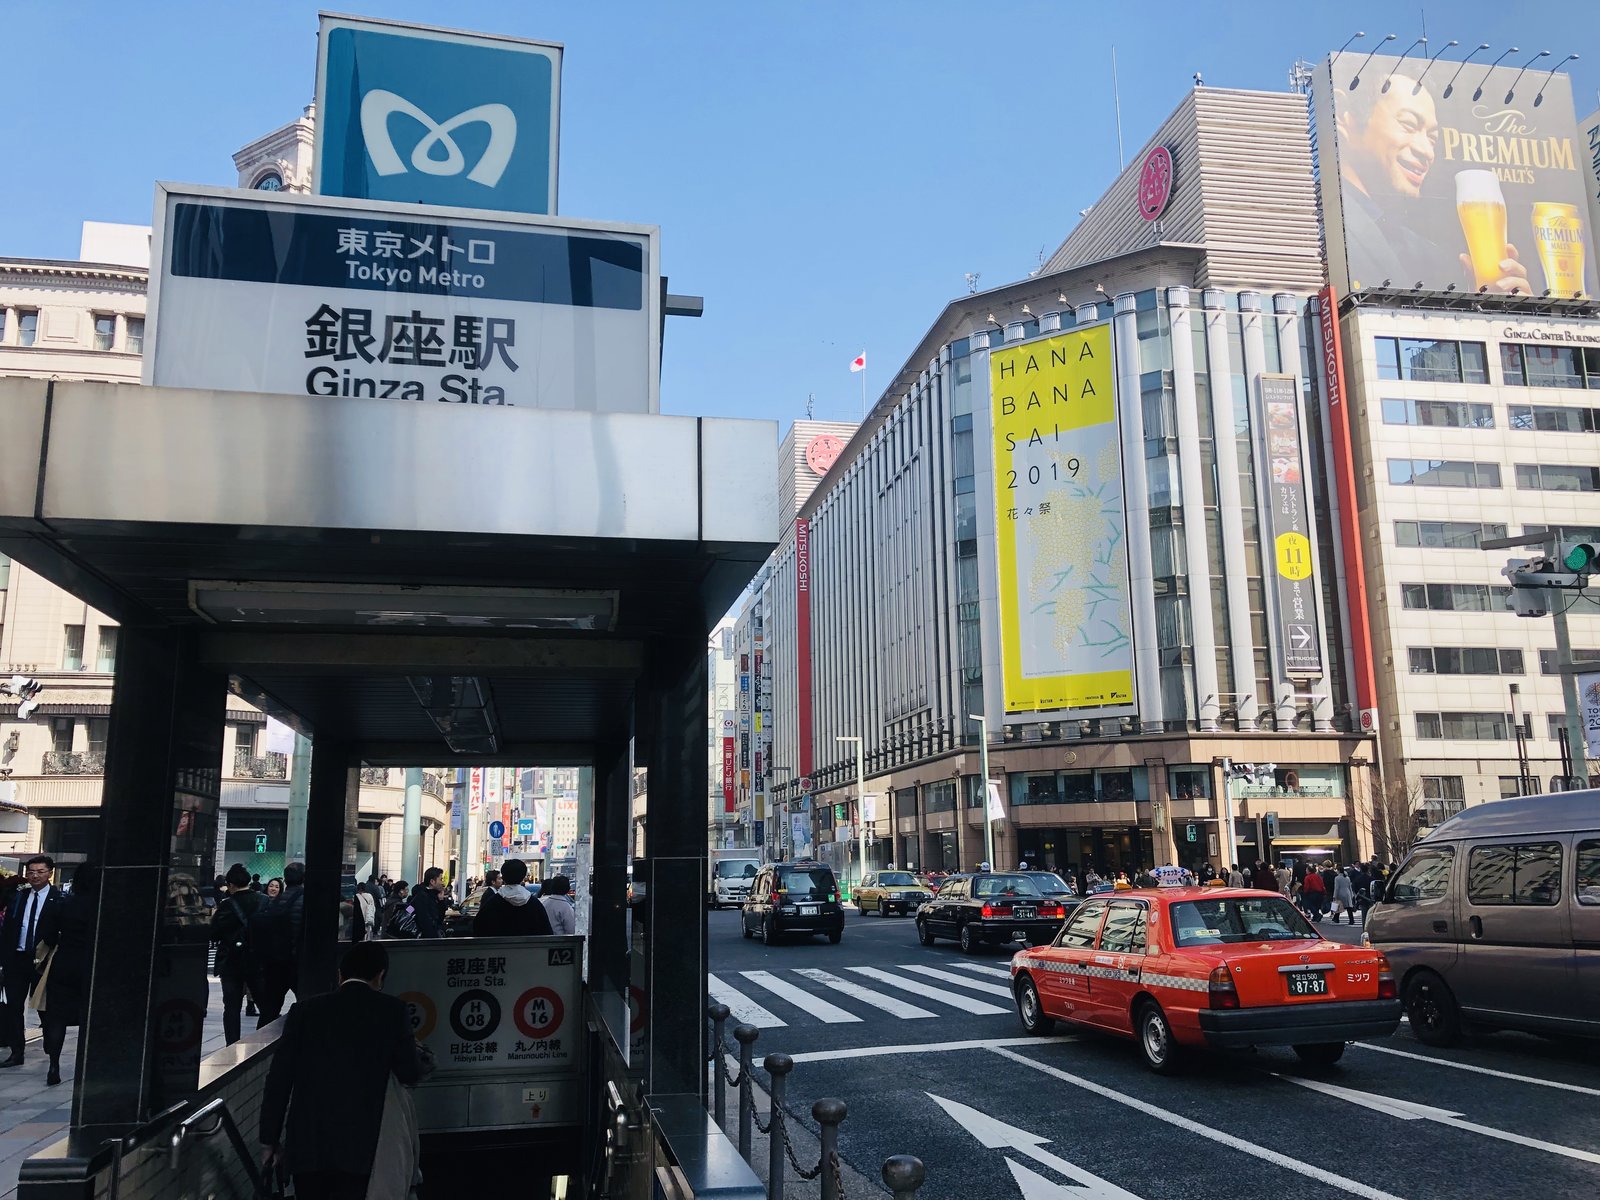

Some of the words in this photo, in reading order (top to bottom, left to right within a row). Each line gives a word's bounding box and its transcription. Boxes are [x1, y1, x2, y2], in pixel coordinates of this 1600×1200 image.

[1472, 105, 1536, 135] The
[1442, 127, 1576, 171] PREMIUM
[1492, 167, 1536, 184] MALT'S
[335, 228, 496, 265] 東京メトロ
[345, 260, 412, 286] Tokyo
[418, 266, 485, 289] Metro
[304, 303, 519, 374] 銀座駅
[1503, 327, 1532, 340] GINZA
[1532, 329, 1564, 341] CENTER
[1322, 296, 1339, 406] MITSUKOSHI
[1000, 341, 1094, 380] HANA
[306, 366, 425, 402] Ginza
[438, 373, 516, 406] Sta.
[1002, 378, 1096, 416] BANA
[1006, 423, 1059, 452] SAI
[1006, 458, 1080, 489] 2019
[1007, 502, 1051, 520] 花々祭
[799, 524, 808, 592] MITSUKOSHI
[551, 950, 572, 964] A2
[447, 957, 506, 976] 銀座駅
[447, 976, 480, 988] Ginza
[484, 976, 506, 987] Sta.
[1296, 980, 1325, 993] 87-87
[1347, 973, 1370, 983] ミツワ
[471, 1002, 480, 1012] H
[532, 1000, 545, 1010] M
[466, 1015, 485, 1027] 08
[531, 1013, 548, 1024] 16
[450, 1042, 498, 1055] 日比谷線
[515, 1040, 561, 1051] 丸ノ内線
[454, 1054, 478, 1063] Hibiya
[479, 1054, 493, 1062] Line
[507, 1051, 550, 1060] Marunouchi
[525, 1091, 547, 1102] 上り
